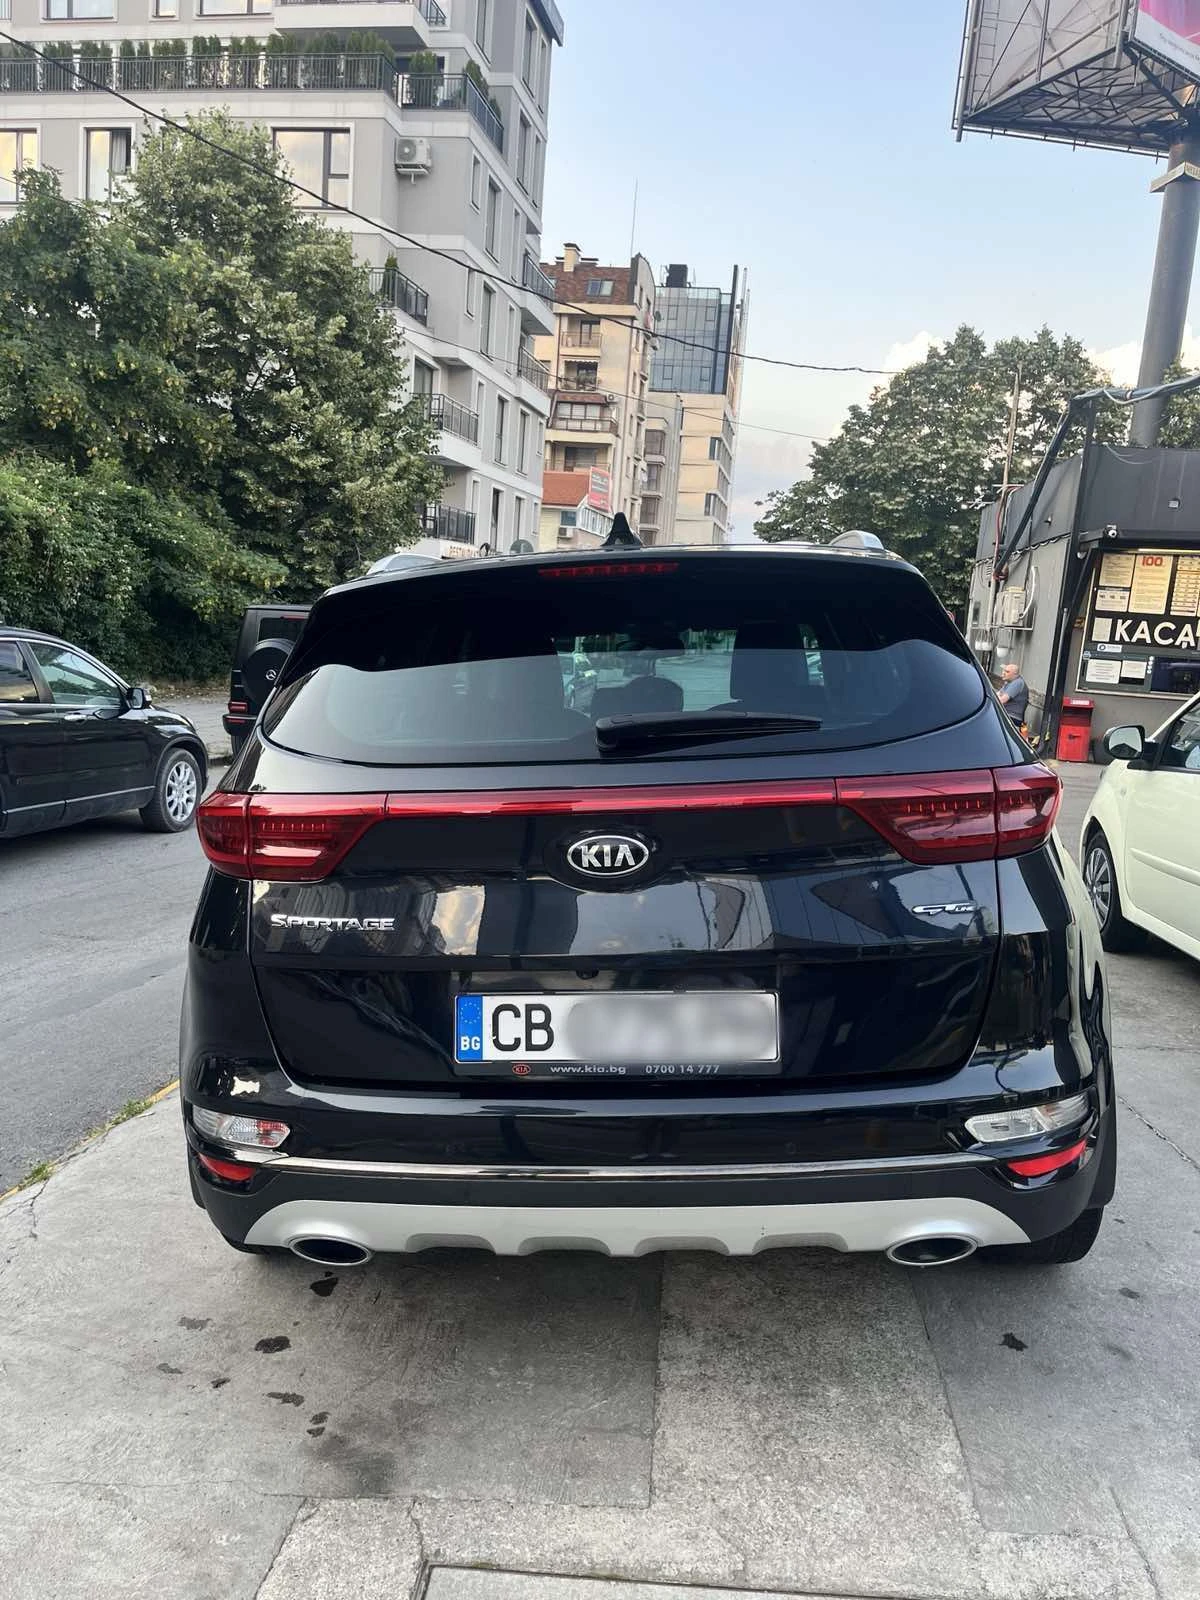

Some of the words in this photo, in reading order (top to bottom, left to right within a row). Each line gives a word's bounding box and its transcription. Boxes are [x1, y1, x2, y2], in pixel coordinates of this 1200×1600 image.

[580, 844, 636, 868] KIA
[270, 913, 396, 932] SPORTAGE
[460, 1035, 481, 1051] BG
[550, 1064, 626, 1075] www.kia.bg
[645, 1064, 675, 1074] 0700
[680, 1064, 694, 1074] 14
[698, 1064, 720, 1074] 777
